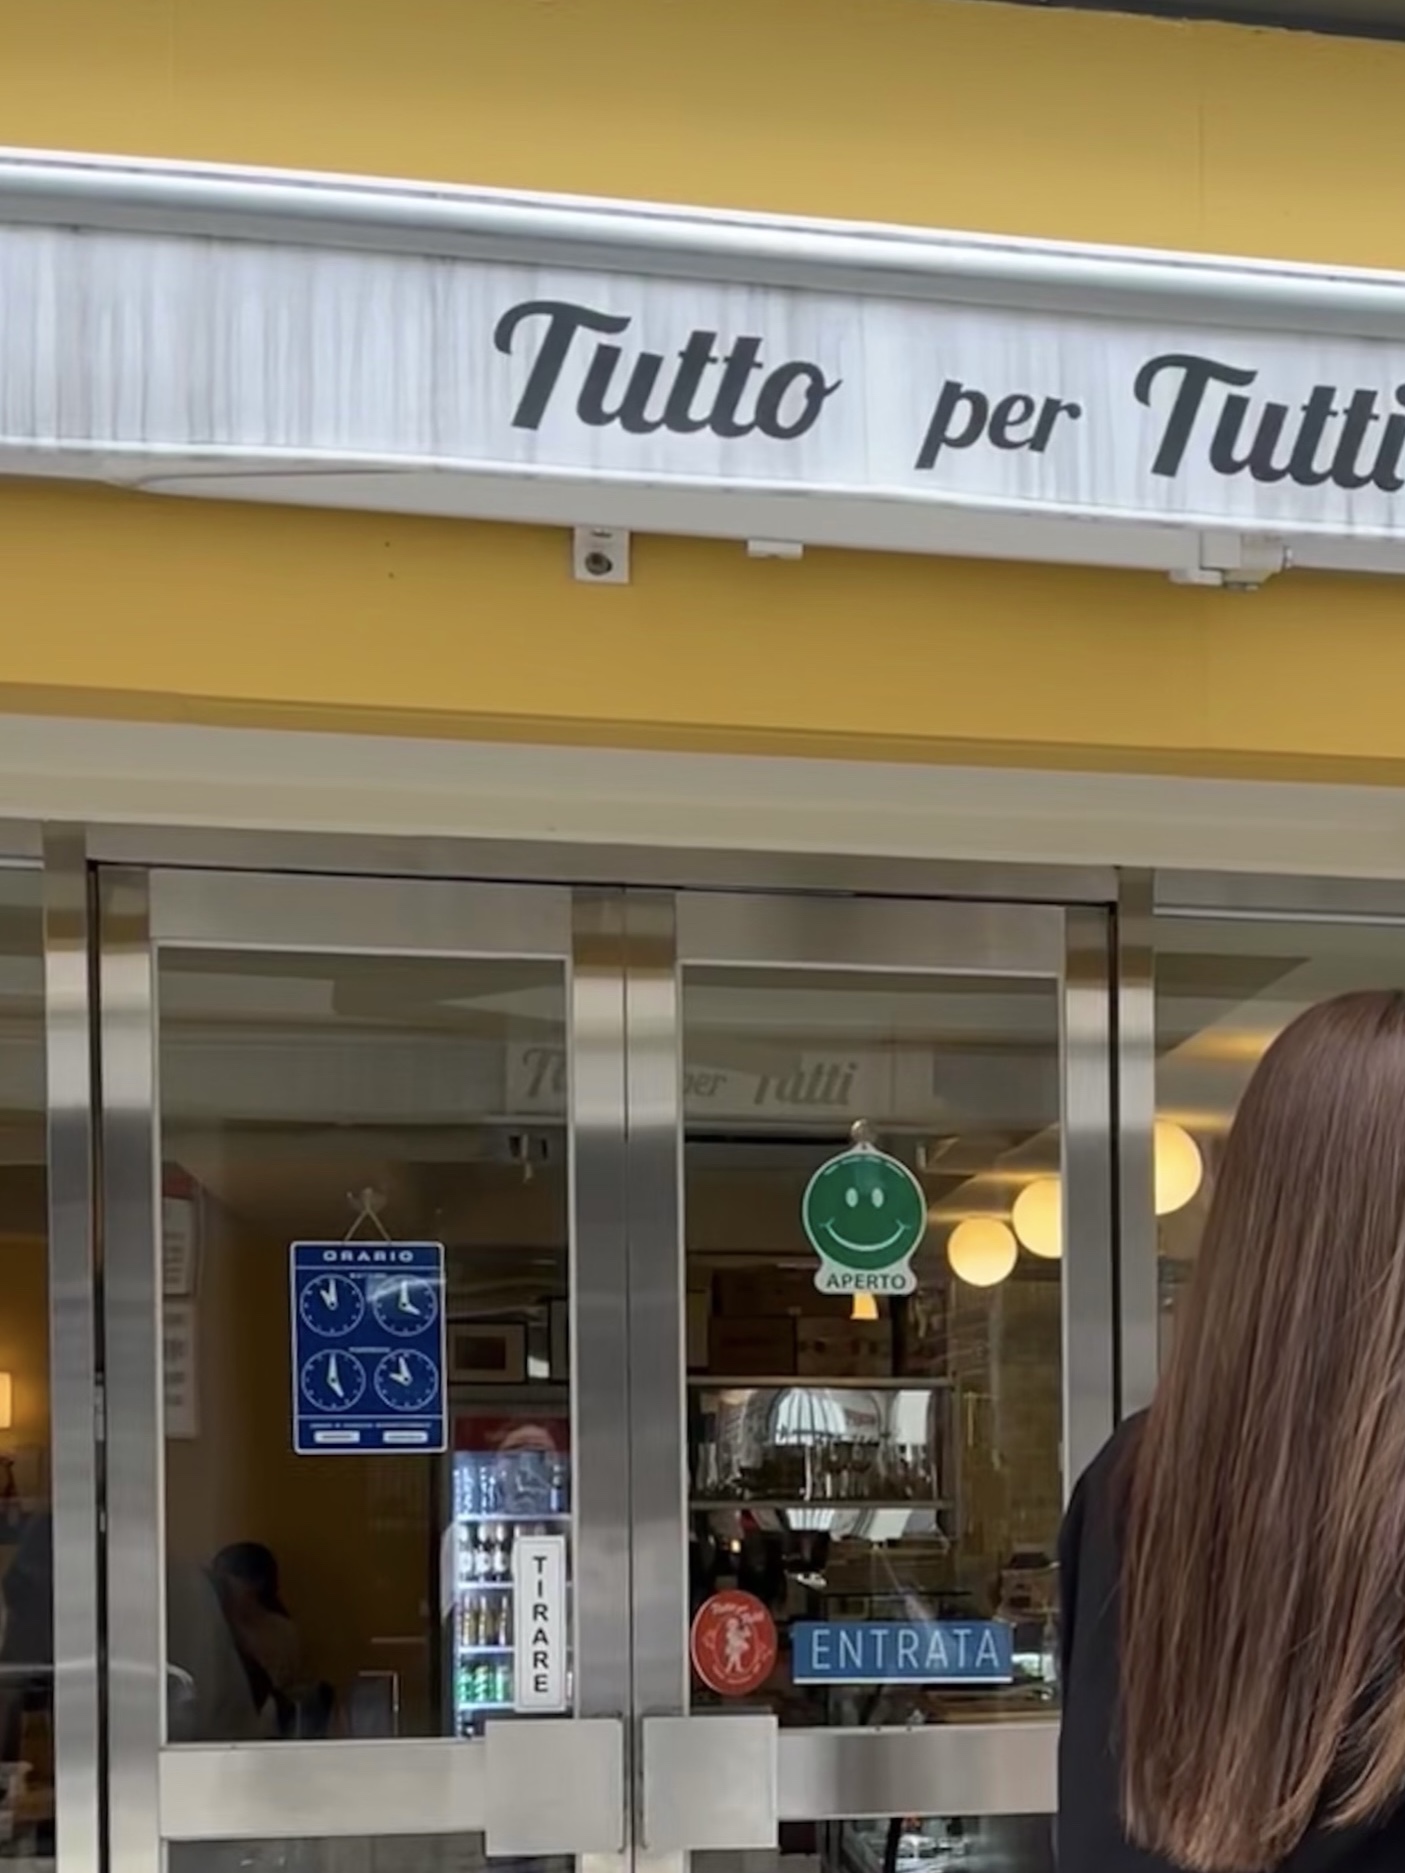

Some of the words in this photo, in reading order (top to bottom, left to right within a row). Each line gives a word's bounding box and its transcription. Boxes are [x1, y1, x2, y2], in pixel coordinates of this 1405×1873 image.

[493, 300, 842, 440] Tutto
[914, 379, 1082, 470] per
[322, 1250, 414, 1262] ORARIO
[826, 1273, 907, 1290] APERTO
[531, 1555, 549, 1693] TIRARE
[810, 1628, 1002, 1671] ENTRATA
